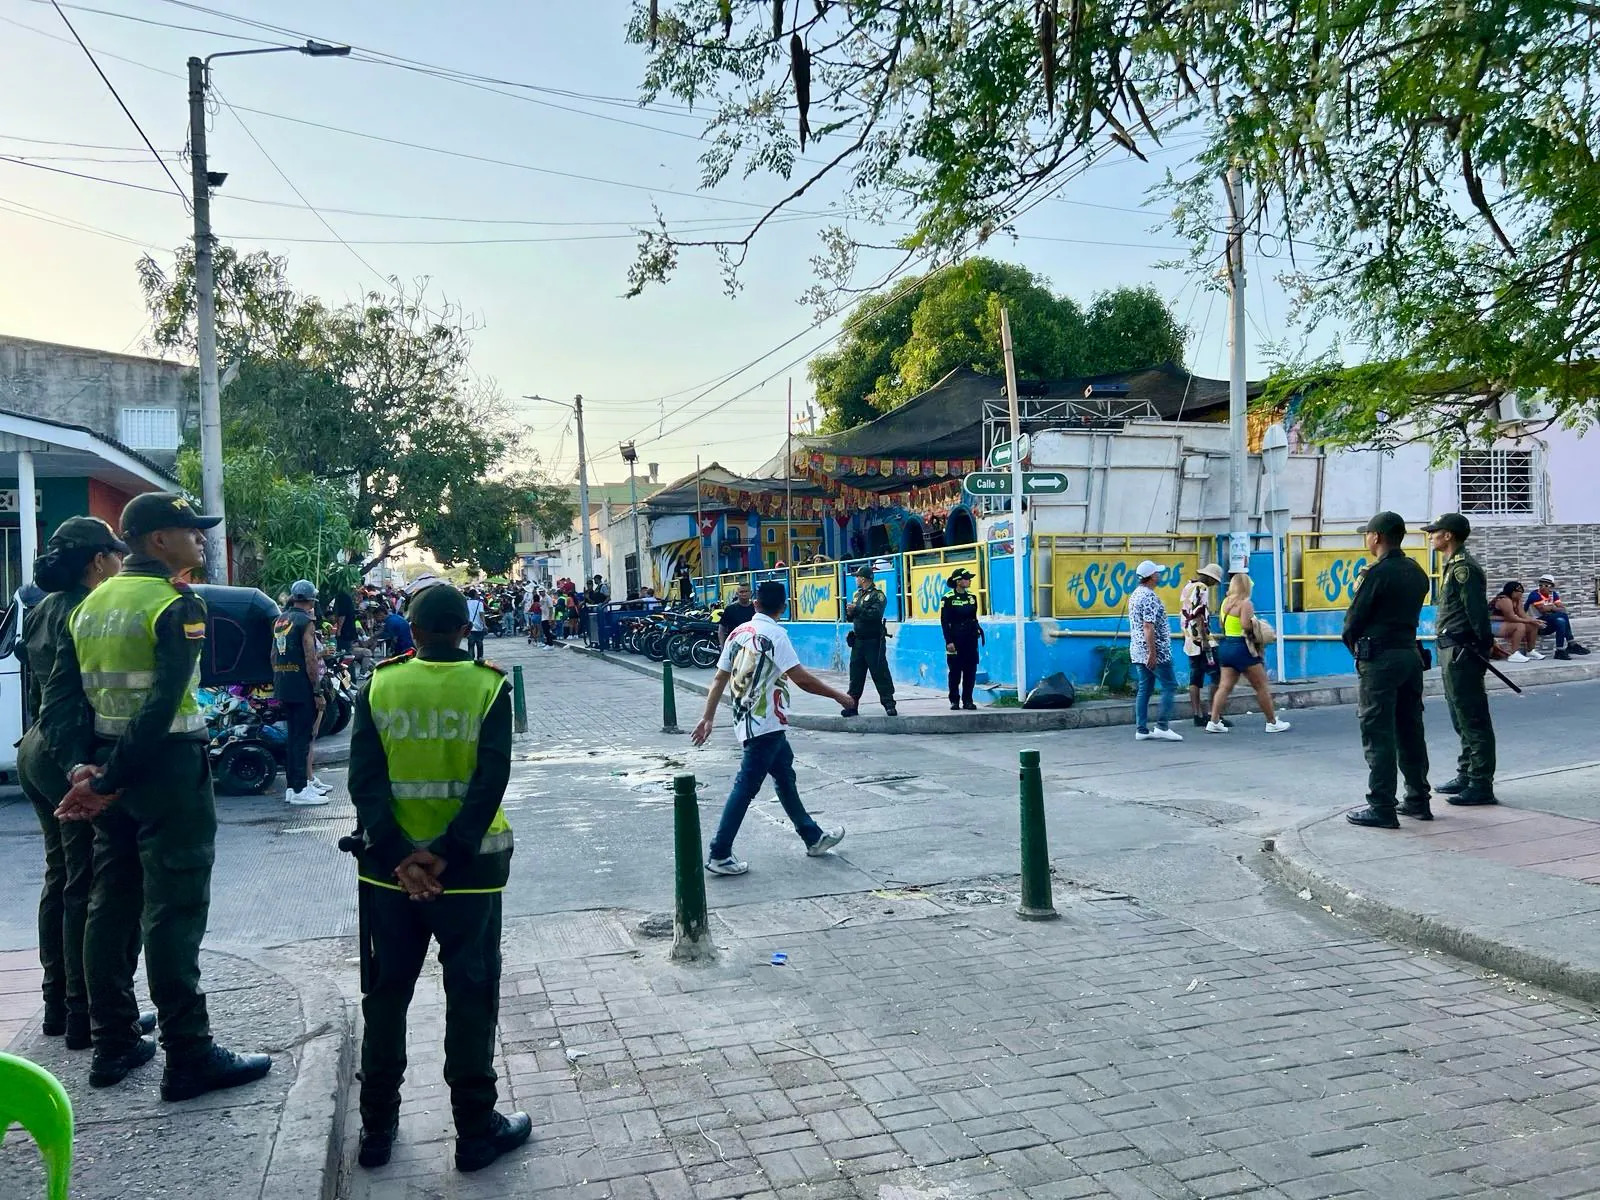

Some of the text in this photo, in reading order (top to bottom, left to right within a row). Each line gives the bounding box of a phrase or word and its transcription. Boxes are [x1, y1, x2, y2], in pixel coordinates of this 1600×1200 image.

[977, 479, 1005, 489] Calle 9
[1067, 561, 1184, 609] #SiSoos
